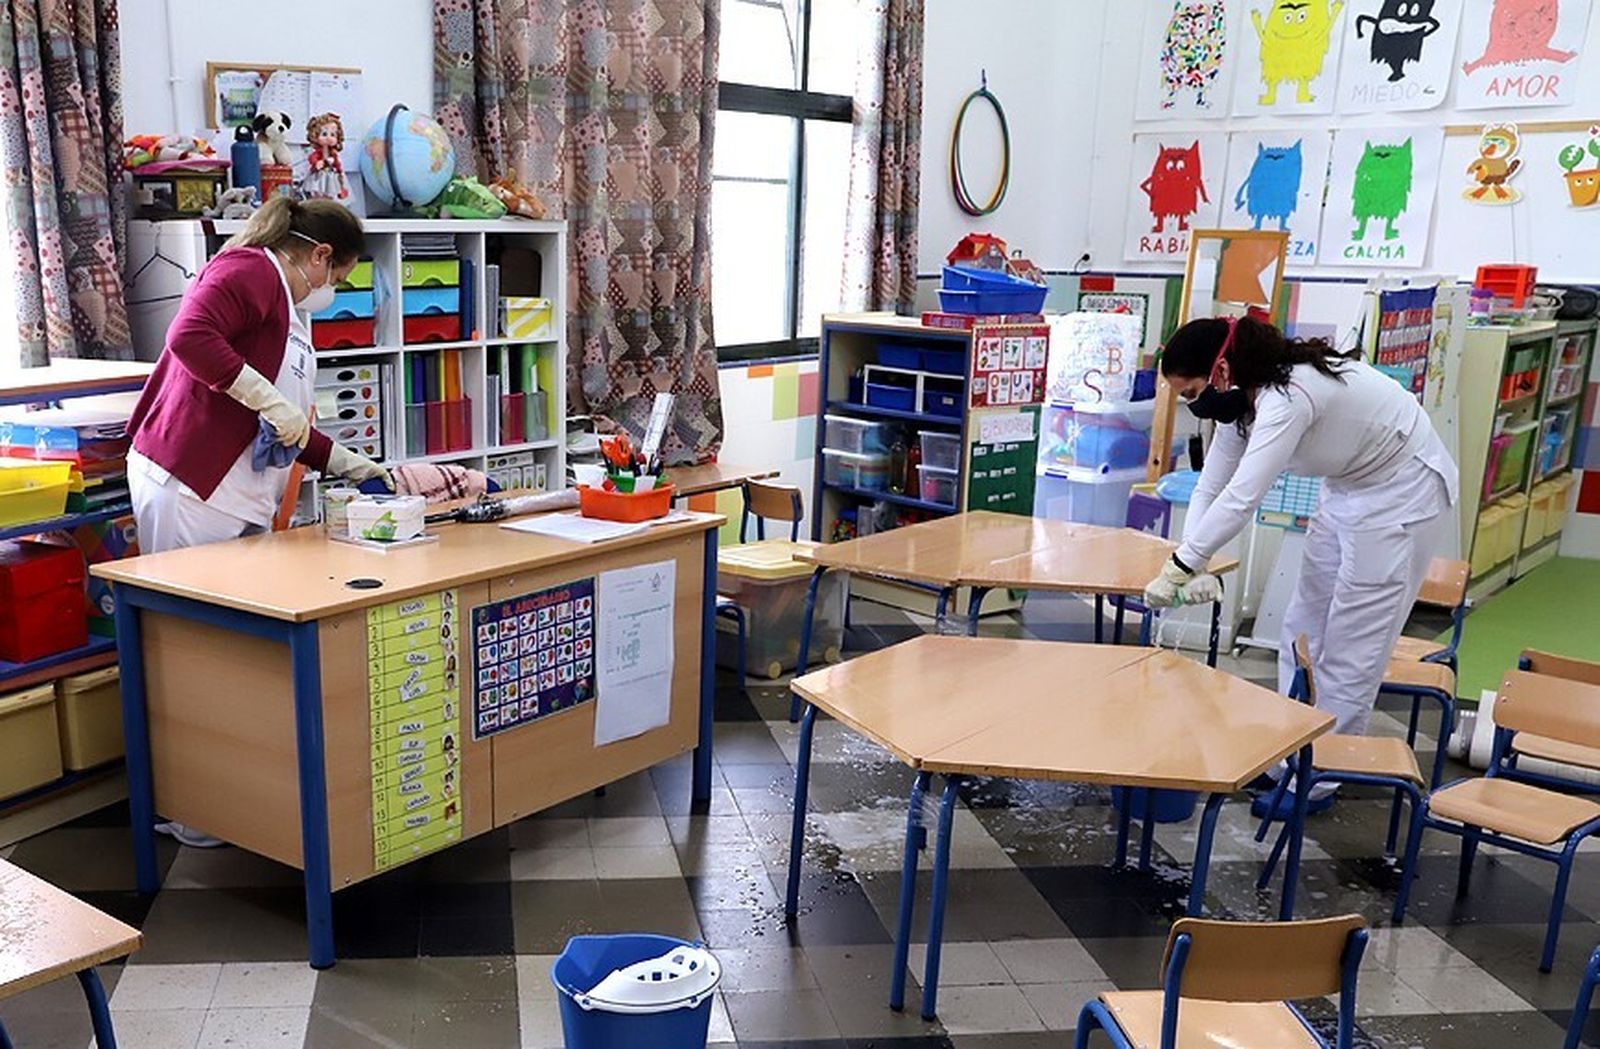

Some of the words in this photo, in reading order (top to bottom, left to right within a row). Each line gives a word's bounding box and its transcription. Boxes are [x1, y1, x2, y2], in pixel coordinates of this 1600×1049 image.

[1350, 82, 1420, 103] MIEDO
[1485, 75, 1560, 97] AMOR
[1285, 241, 1315, 256] EZA
[1344, 245, 1405, 259] CALMA
[981, 341, 988, 353] A
[1004, 340, 1010, 353] E
[1106, 347, 1124, 375] B
[991, 374, 999, 388] O
[1013, 374, 1022, 388] U
[1083, 369, 1102, 404] S
